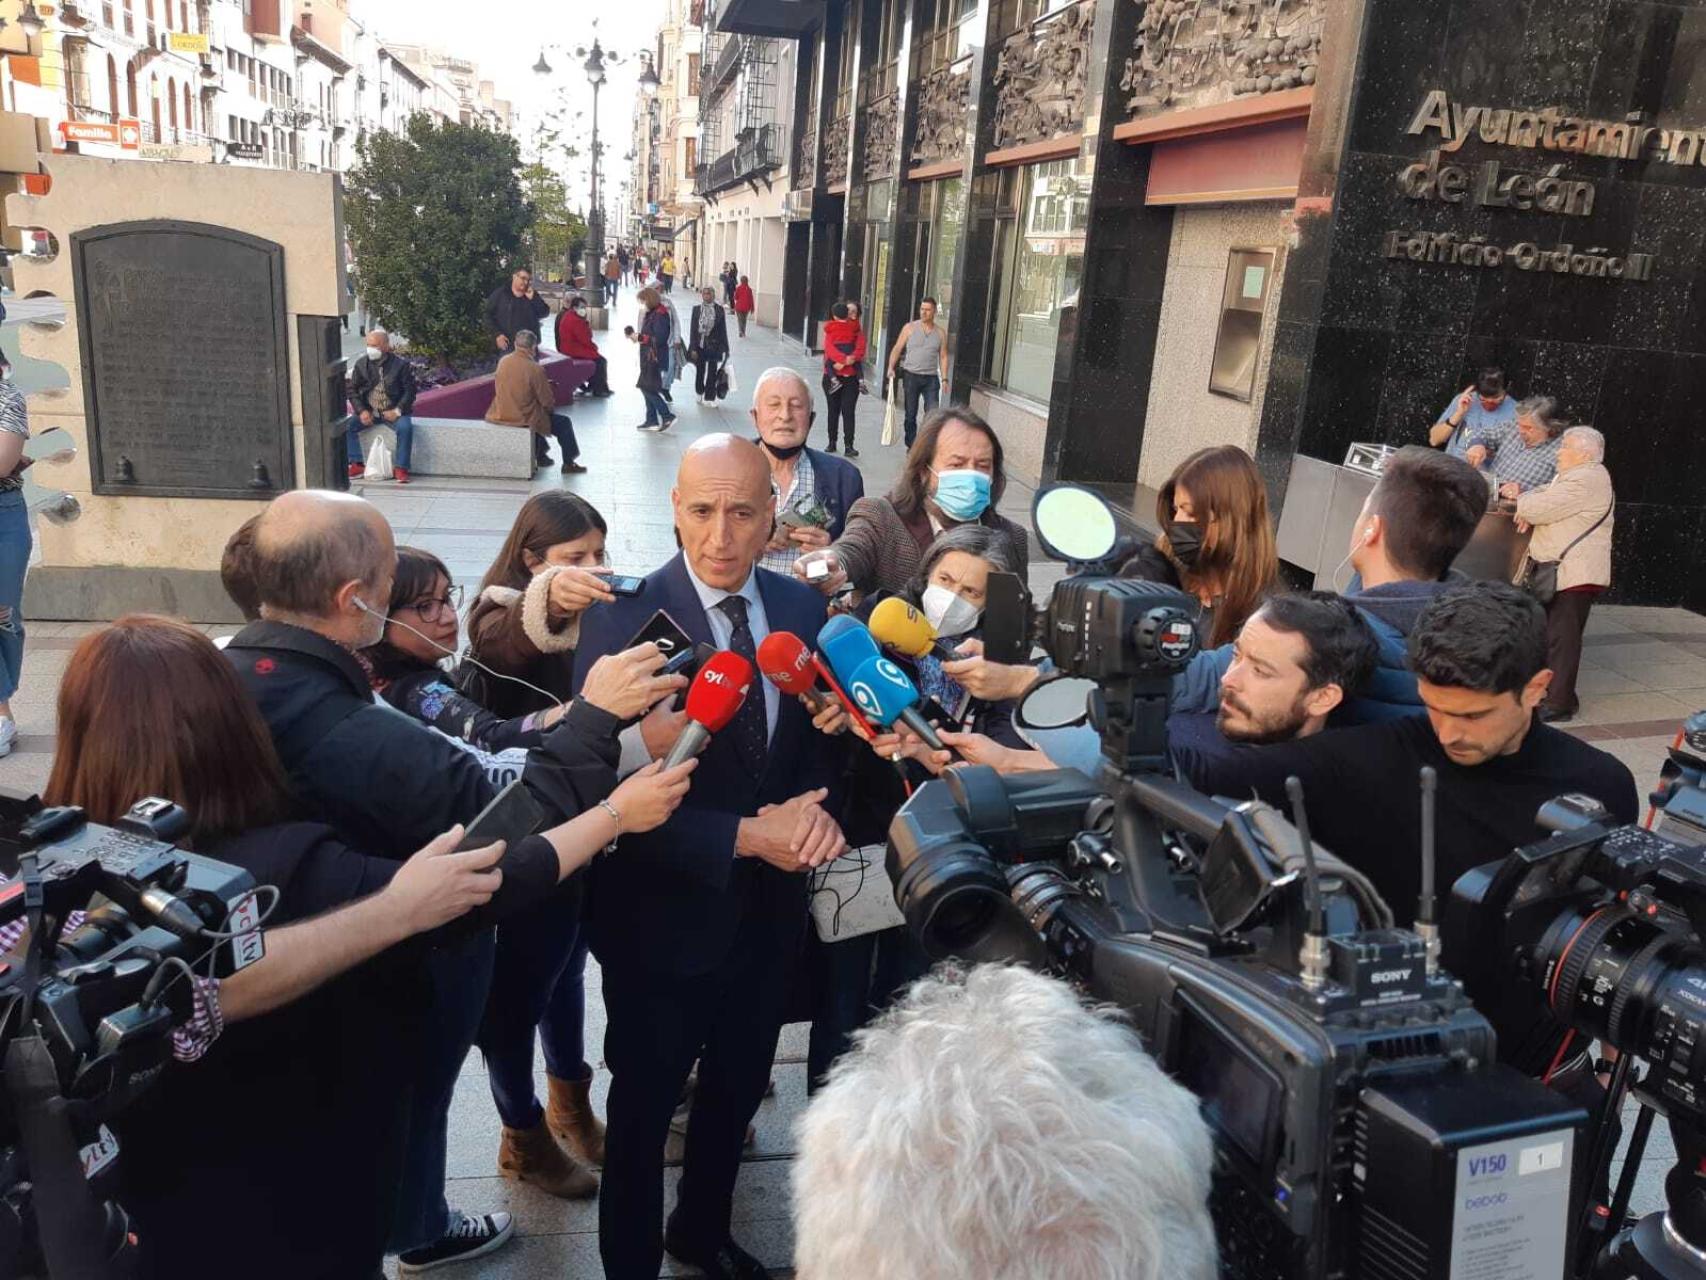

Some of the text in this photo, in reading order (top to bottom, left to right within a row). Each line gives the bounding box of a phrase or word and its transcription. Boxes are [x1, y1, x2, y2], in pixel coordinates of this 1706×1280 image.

[1401, 147, 1596, 216] de León
[1385, 231, 1502, 268] Edificio
[1505, 242, 1625, 277] Ordoño
[795, 646, 811, 671] rne
[1371, 969, 1412, 984] SONY
[1469, 1154, 1507, 1177] V150
